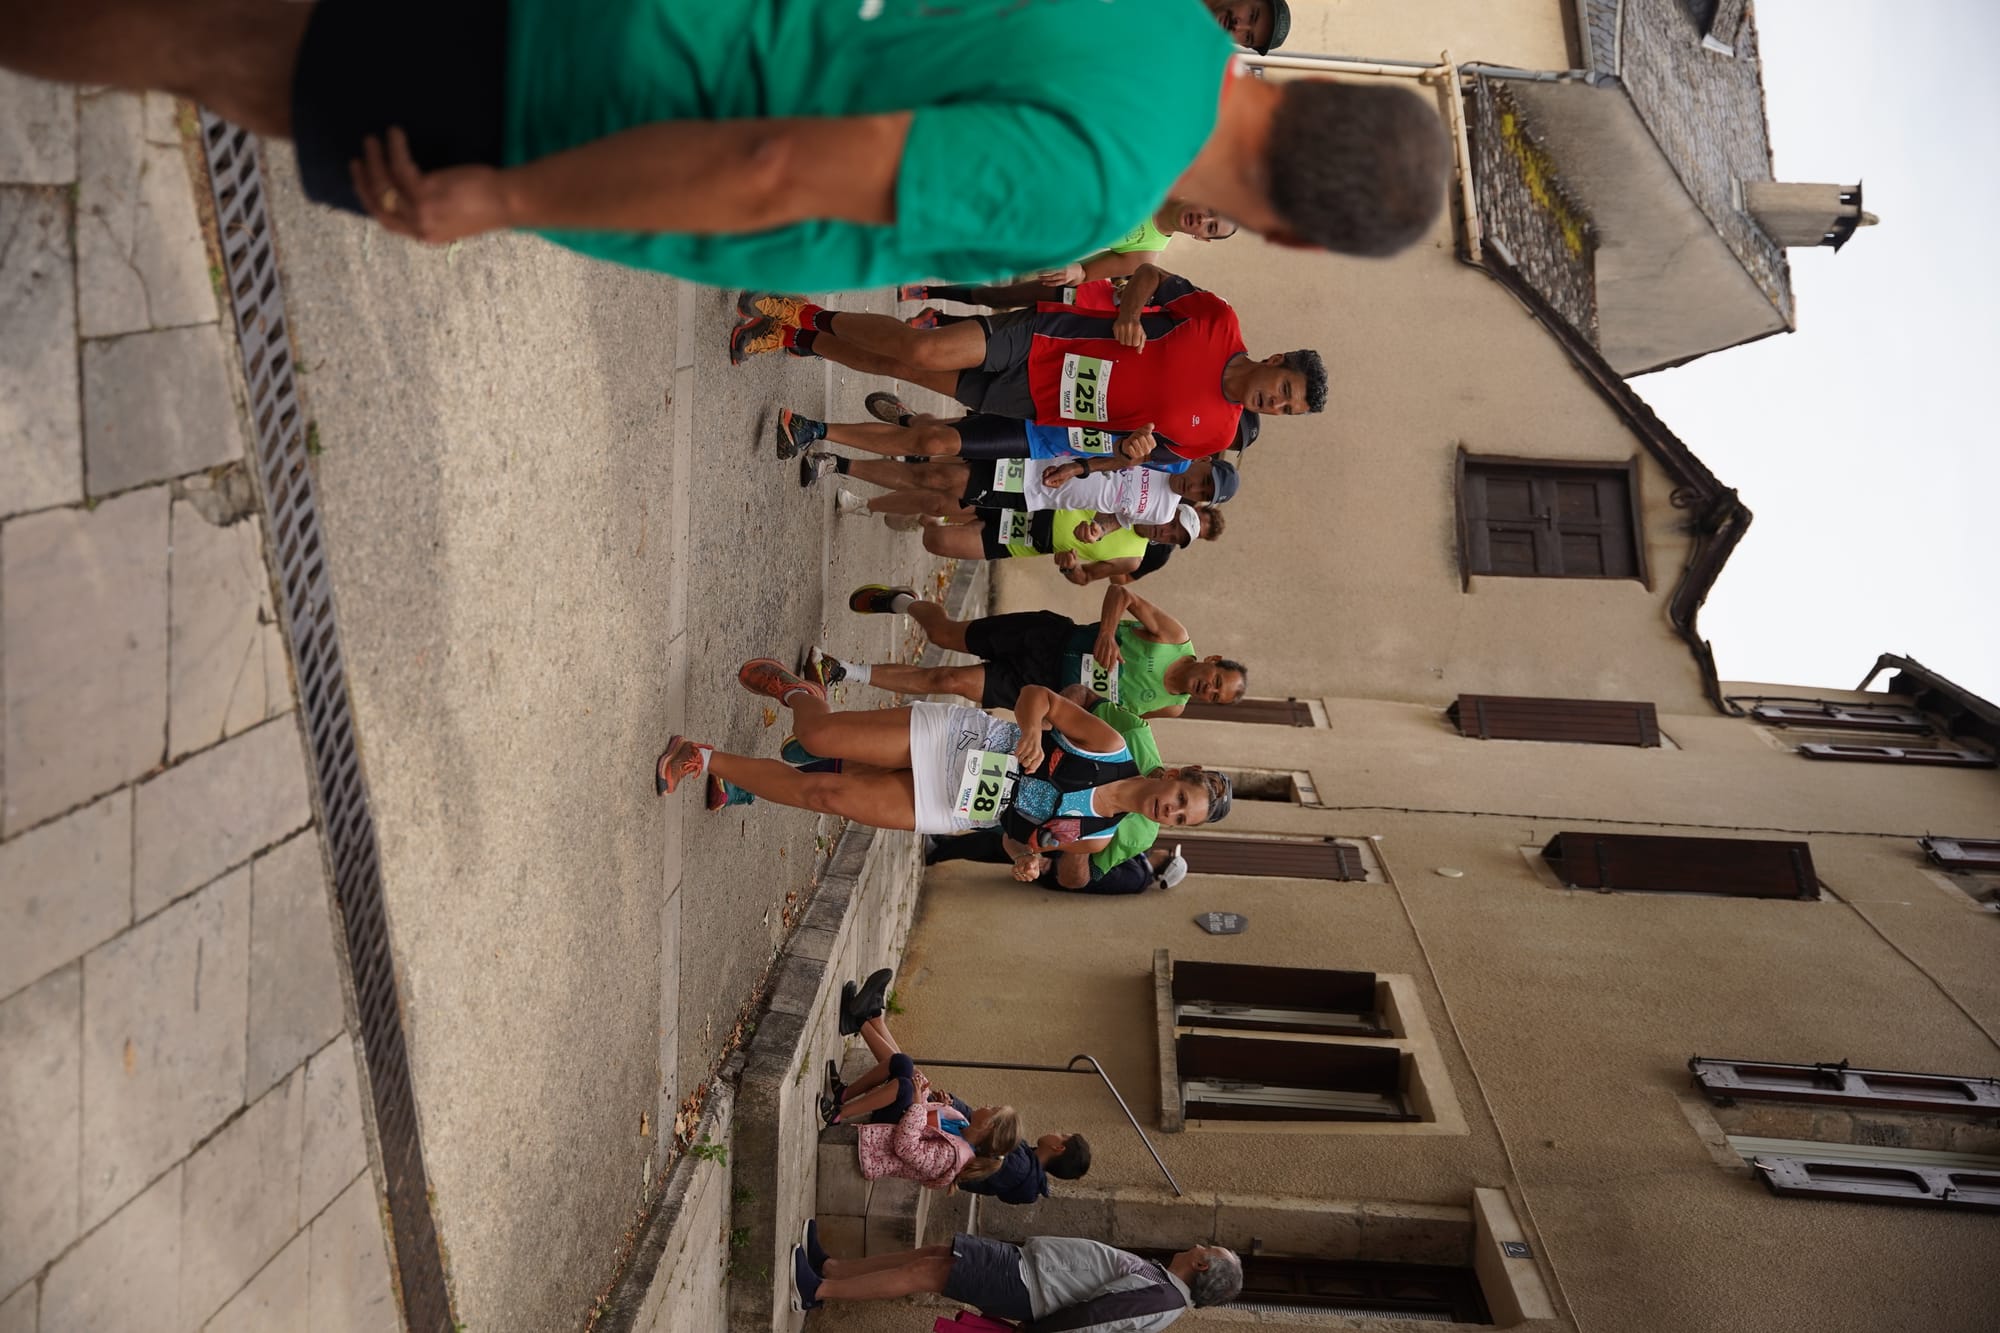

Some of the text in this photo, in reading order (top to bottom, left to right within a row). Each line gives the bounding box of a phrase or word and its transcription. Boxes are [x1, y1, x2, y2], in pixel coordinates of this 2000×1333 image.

[1076, 368, 1096, 414] 125
[1010, 516, 1025, 539] 24
[1093, 669, 1108, 692] 30
[974, 764, 1002, 812] 128
